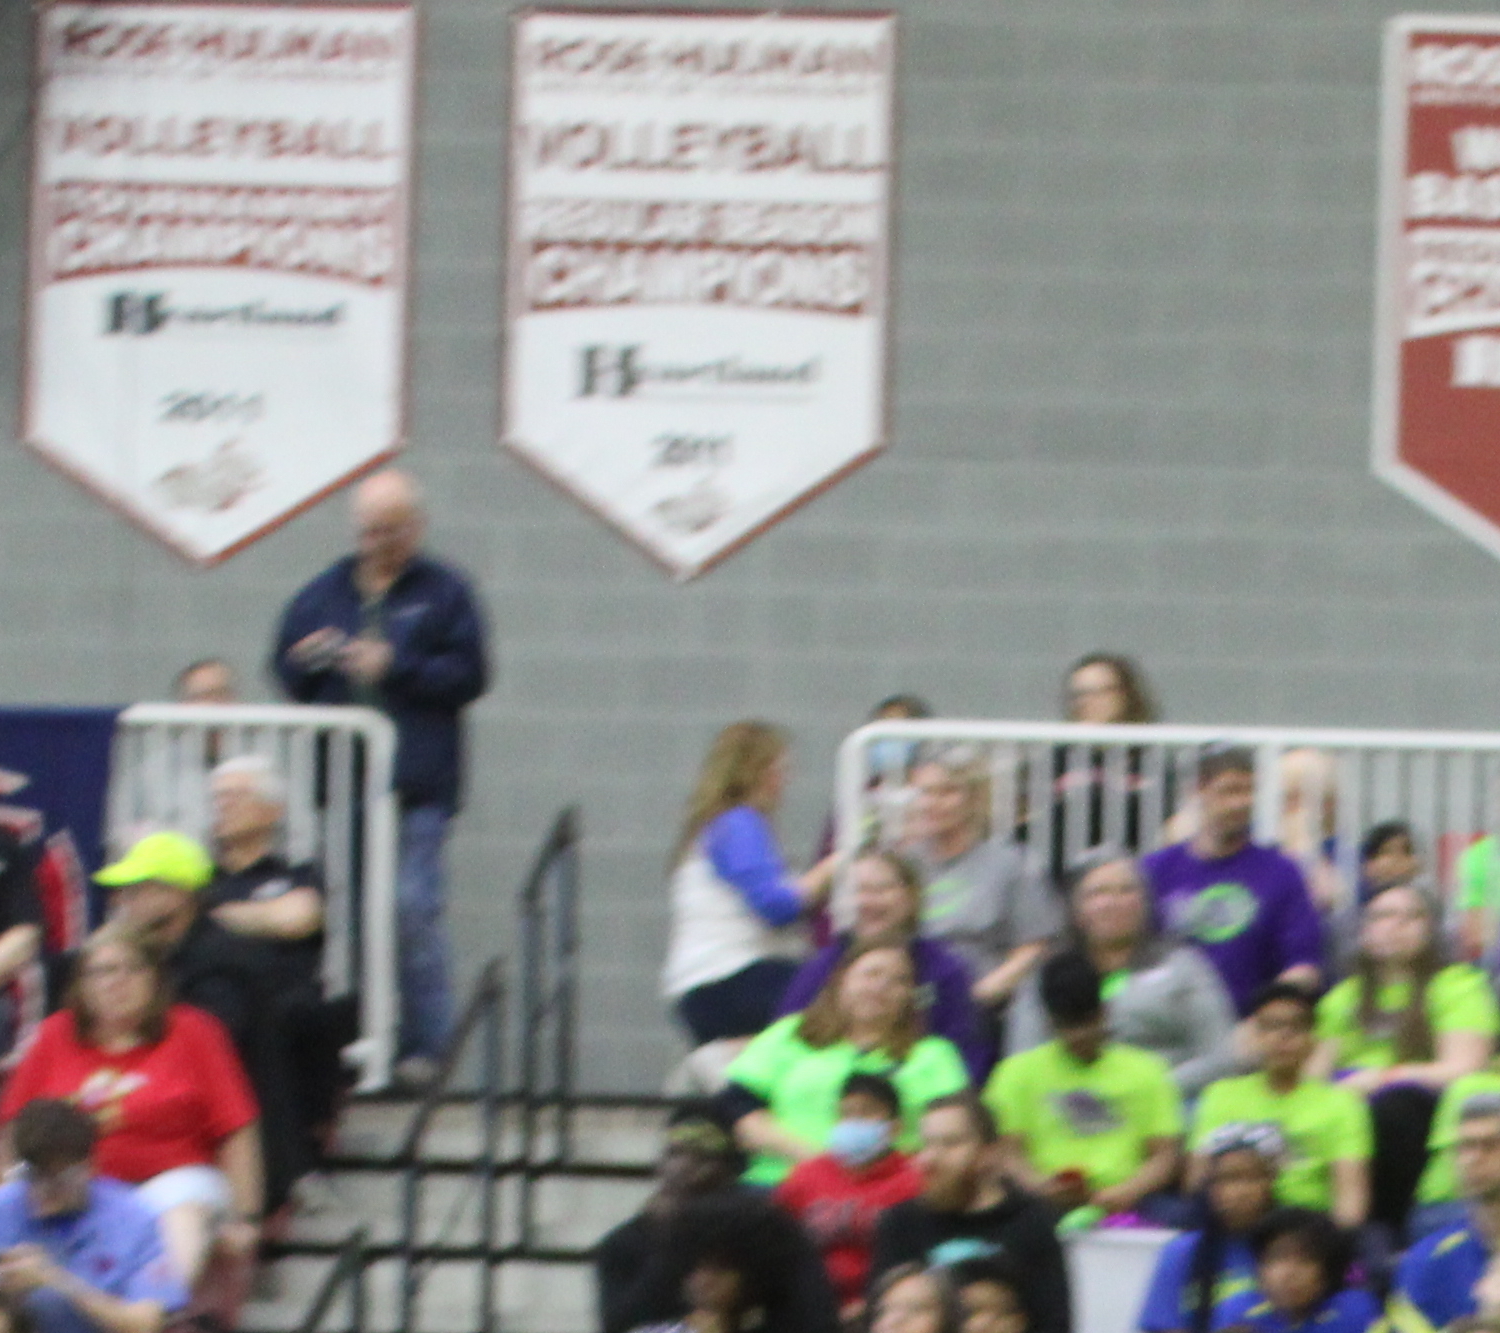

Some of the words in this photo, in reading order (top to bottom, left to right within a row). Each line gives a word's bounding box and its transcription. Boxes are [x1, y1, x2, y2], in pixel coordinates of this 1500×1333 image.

[53, 115, 391, 160] VOLLEYBALL
[528, 122, 882, 174] VOLLEYBALL
[56, 218, 385, 276] CHAMPIONS
[531, 249, 864, 305] CHAMPIONS
